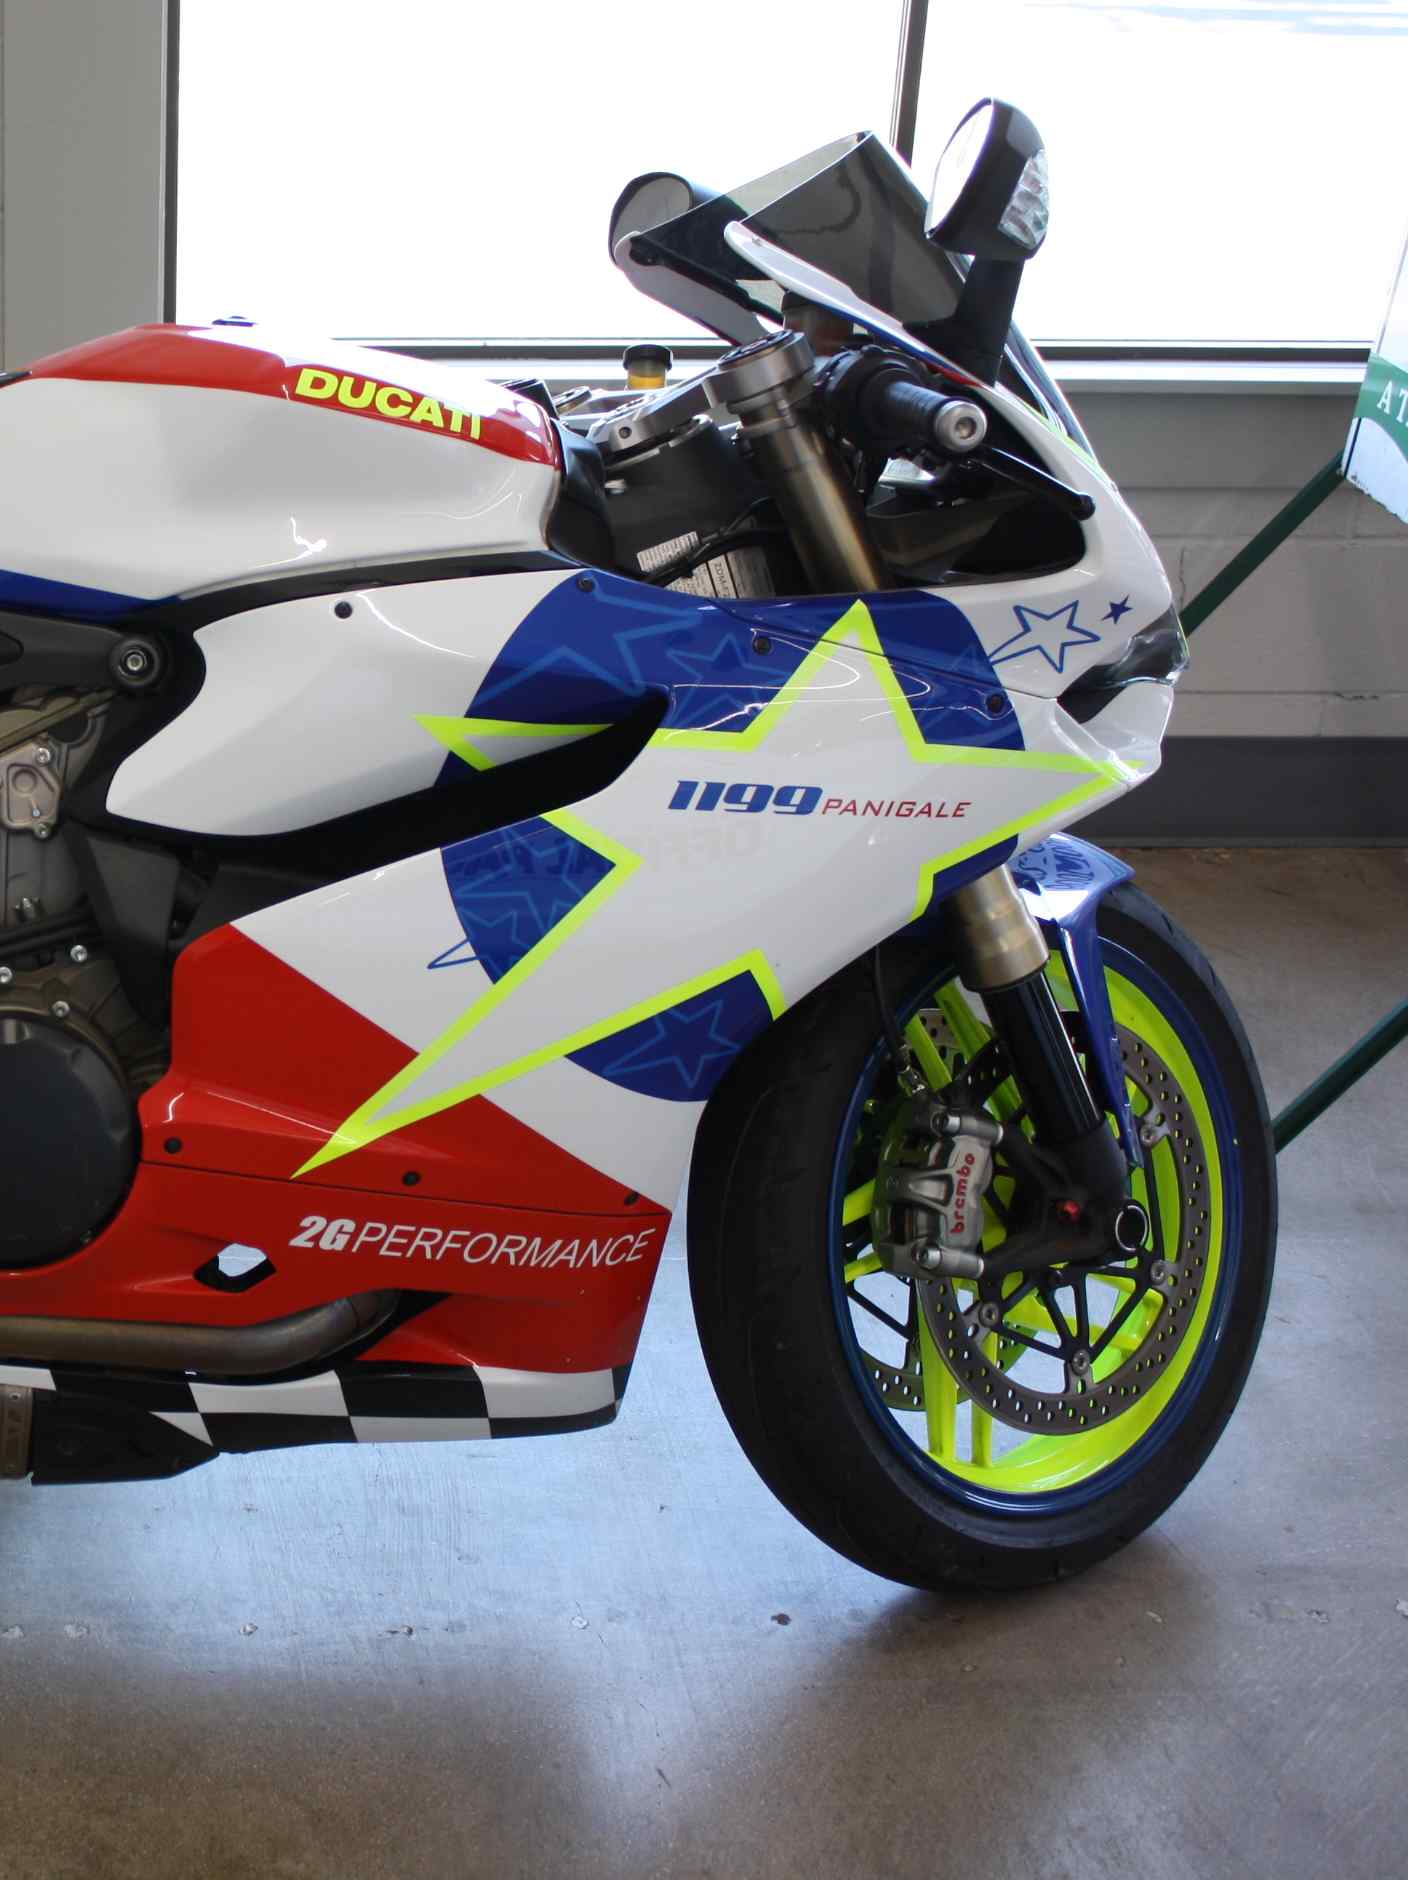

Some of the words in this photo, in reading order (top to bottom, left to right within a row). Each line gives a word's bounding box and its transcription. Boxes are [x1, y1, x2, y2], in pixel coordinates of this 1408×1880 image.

[295, 368, 481, 440] DUCATI
[668, 780, 823, 815] 1199
[822, 798, 972, 818] PANIGALE
[950, 1153, 976, 1234] brembo
[352, 1222, 656, 1268] PERFORMANCE
